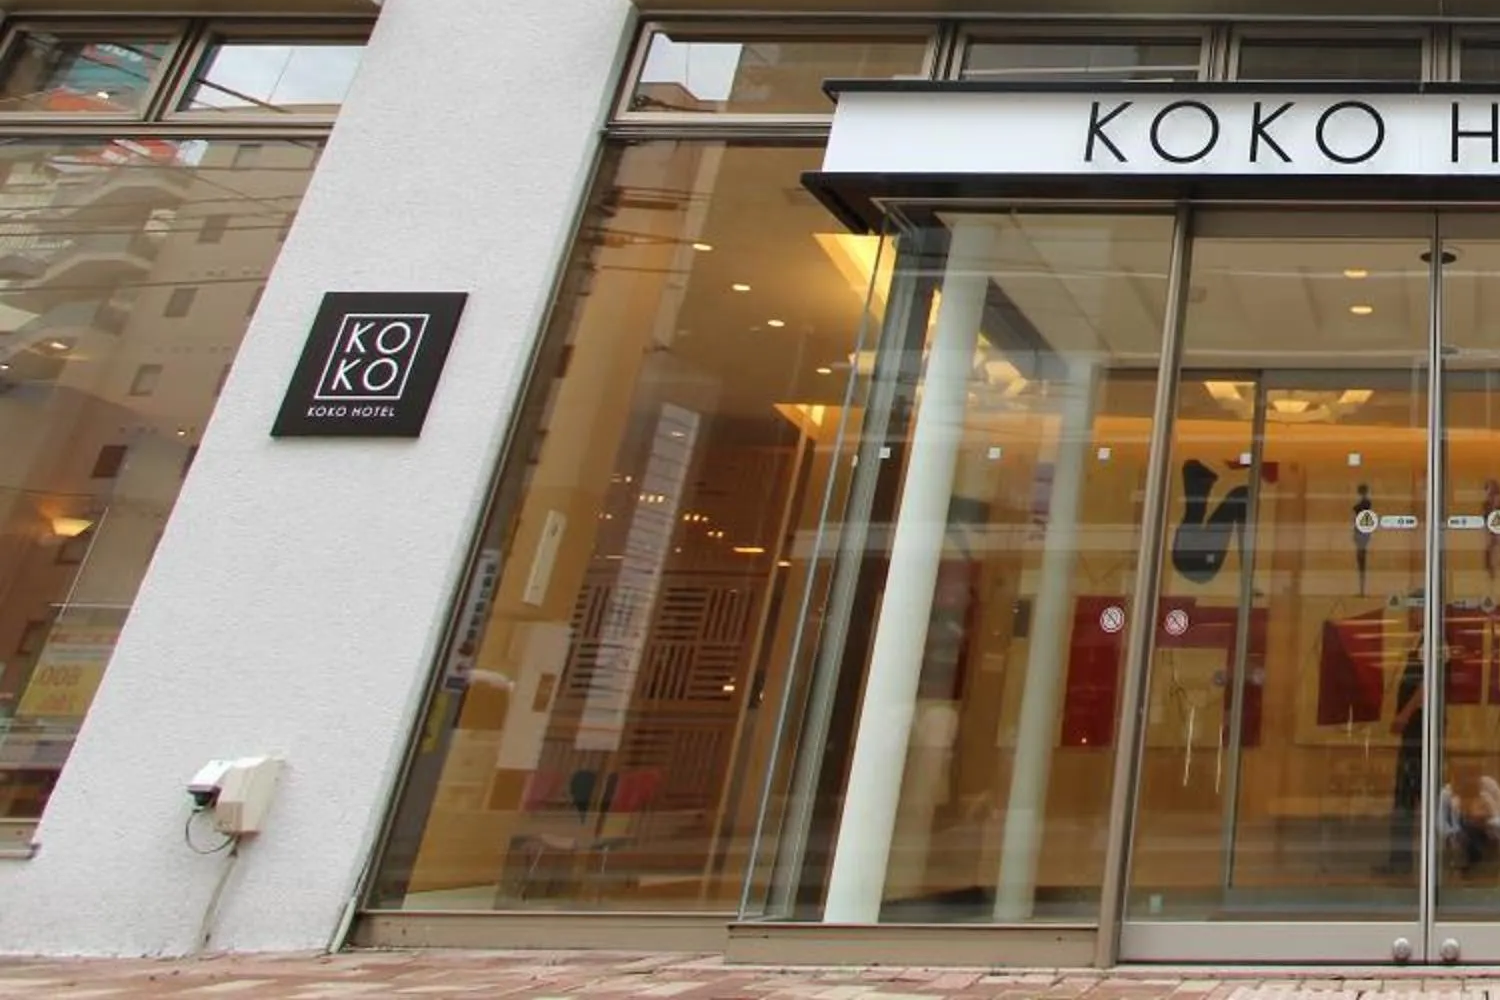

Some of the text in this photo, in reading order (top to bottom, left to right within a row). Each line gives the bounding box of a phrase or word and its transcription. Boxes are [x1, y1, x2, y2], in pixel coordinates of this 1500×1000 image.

[1084, 100, 1386, 164] KOKO
[345, 321, 411, 354] KO
[331, 357, 398, 391] KO
[306, 405, 395, 418] KOKO HOTEL
